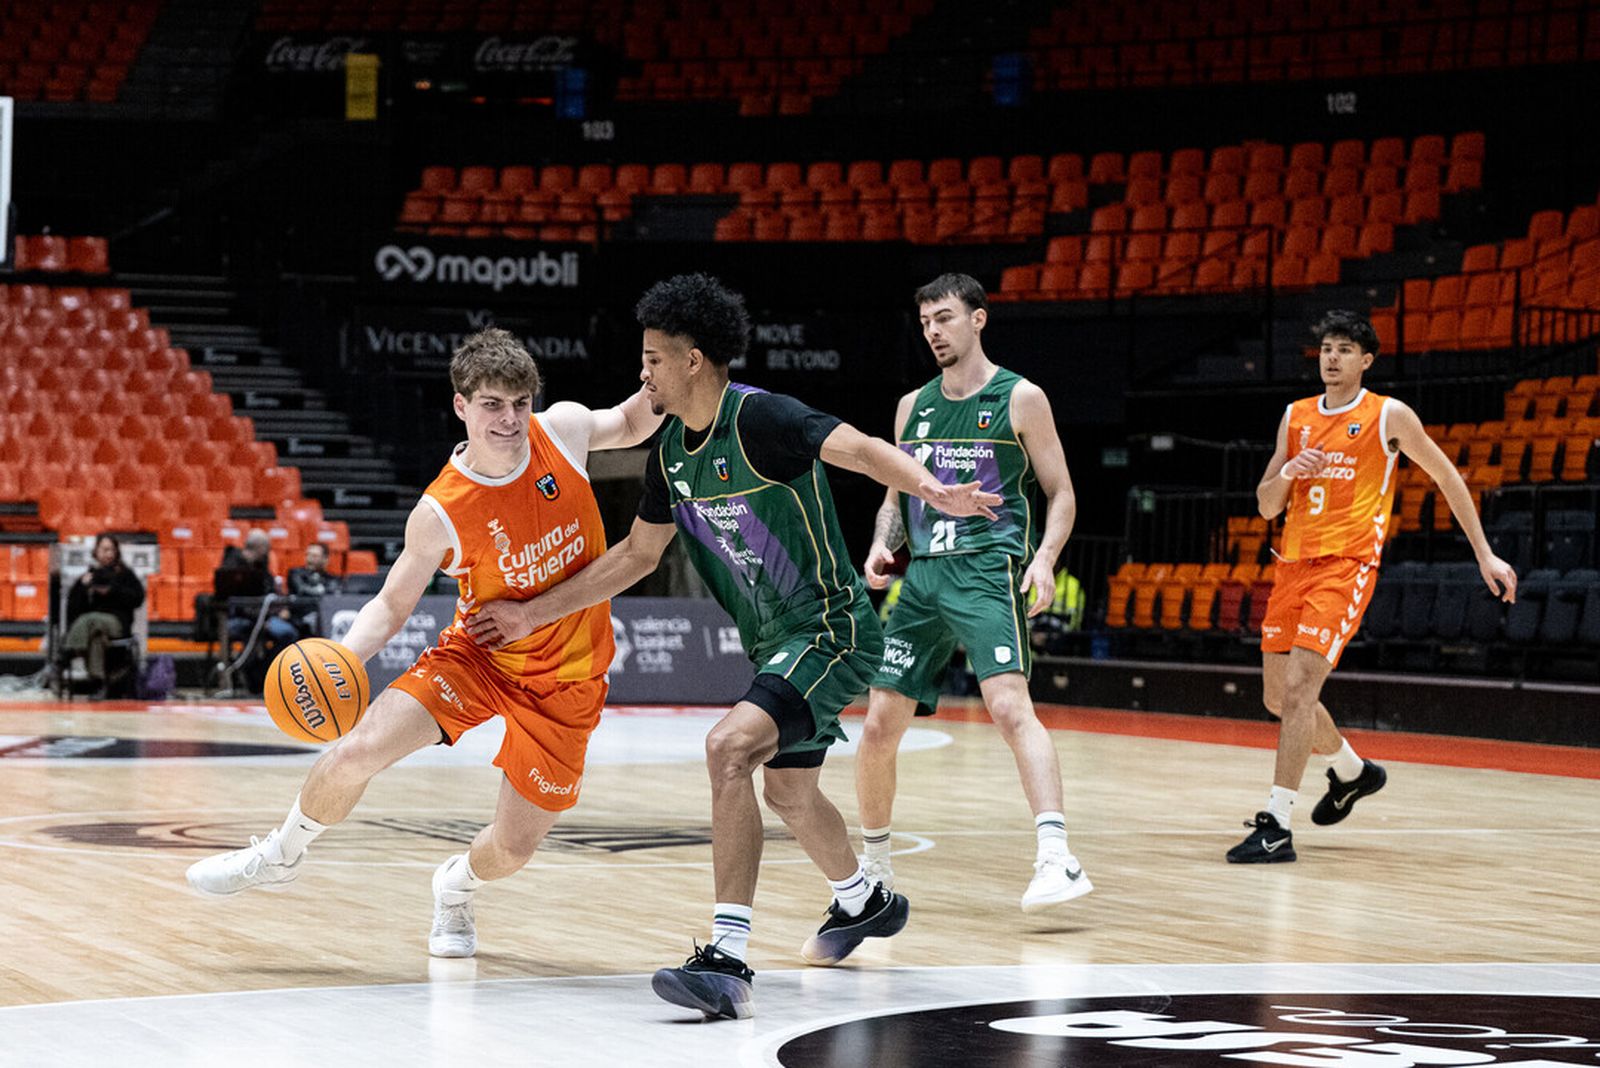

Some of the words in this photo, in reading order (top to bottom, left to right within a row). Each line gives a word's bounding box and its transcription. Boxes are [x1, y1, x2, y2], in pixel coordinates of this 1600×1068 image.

[1327, 92, 1357, 115] 102
[582, 120, 615, 141] 103
[435, 251, 579, 292] mapubli
[364, 326, 465, 355] VICENT
[524, 335, 590, 361] NDIA
[756, 323, 804, 345] MOVE
[767, 350, 841, 371] BEYOND
[936, 446, 994, 460] Fundación
[936, 458, 977, 473] Unicaja
[536, 474, 555, 488] LIGA
[1309, 485, 1325, 515] 9
[564, 518, 580, 538] del
[929, 520, 957, 553] 21
[504, 535, 585, 589] Esfuerzo
[879, 665, 903, 678] ENTAL
[289, 661, 326, 730] Wilson
